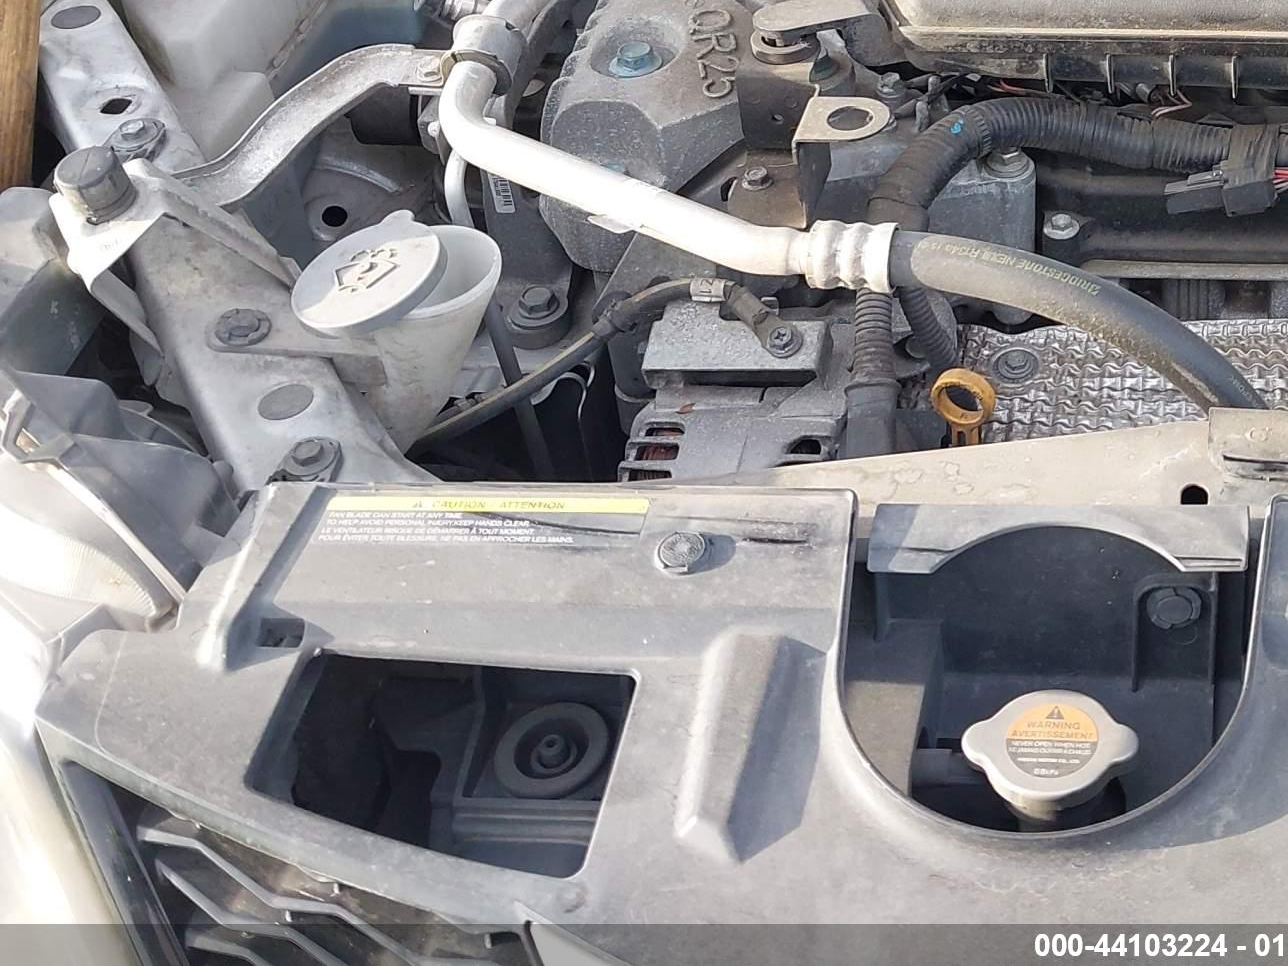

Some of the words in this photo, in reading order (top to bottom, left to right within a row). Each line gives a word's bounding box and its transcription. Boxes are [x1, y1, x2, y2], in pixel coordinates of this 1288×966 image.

[688, 9, 740, 98] QR25
[499, 501, 565, 509] ATTENTION
[1027, 721, 1080, 729] WARNING
[1012, 730, 1093, 739] AVERTISSEMENT
